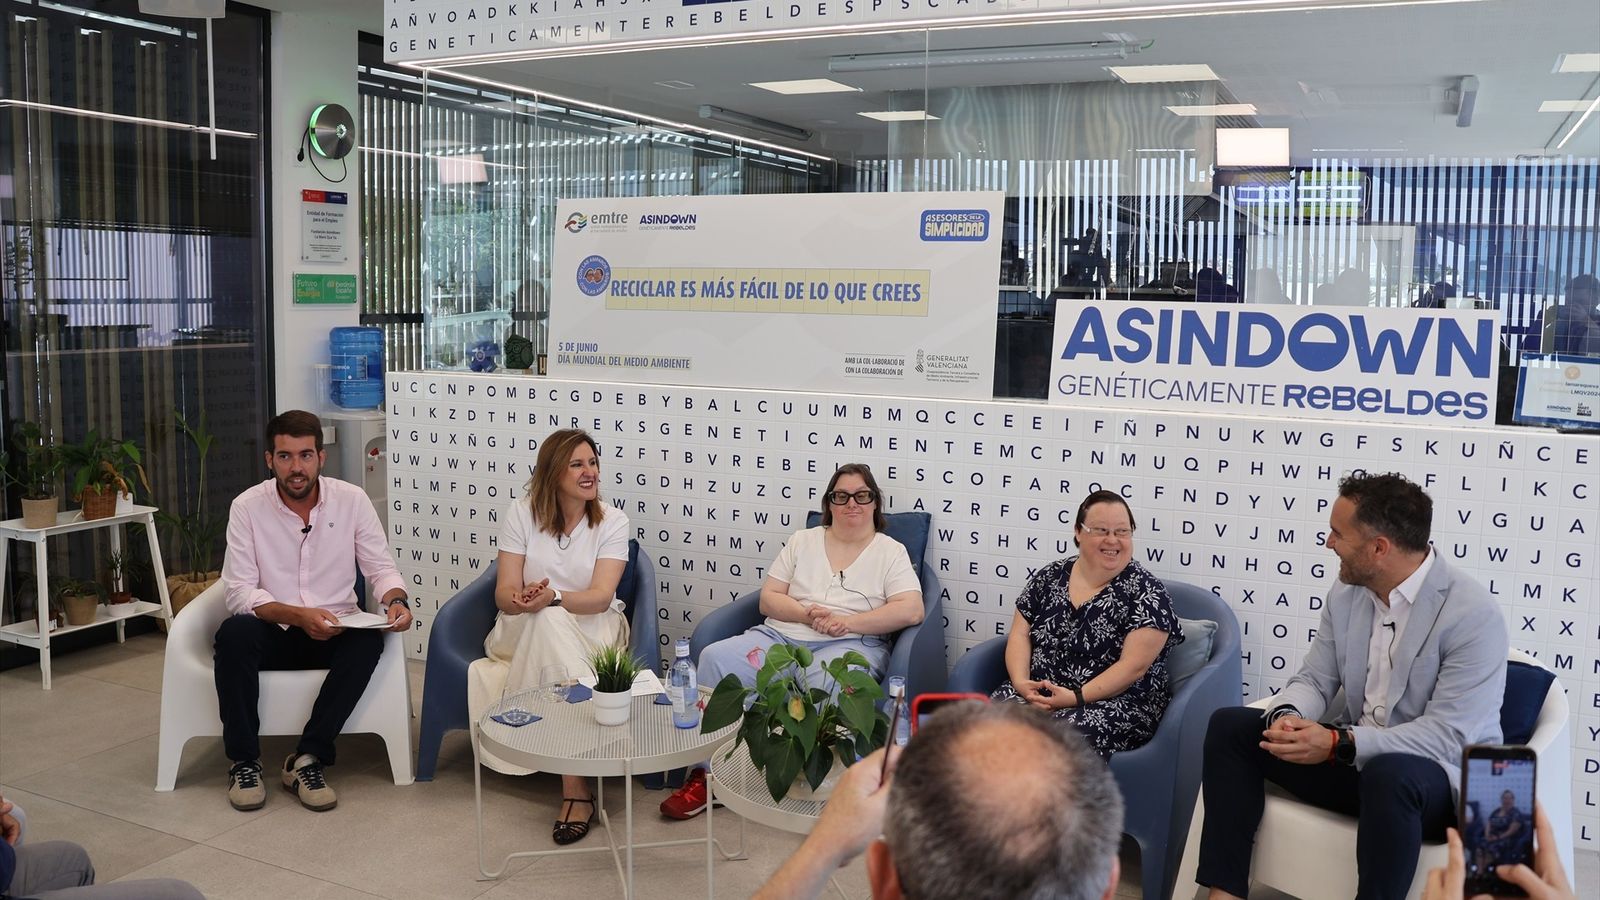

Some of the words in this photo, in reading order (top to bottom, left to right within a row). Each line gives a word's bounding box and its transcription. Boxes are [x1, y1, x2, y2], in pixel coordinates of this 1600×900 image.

[391, 18, 398, 28] A
[409, 16, 416, 26] Ñ
[429, 13, 436, 23] V
[448, 11, 456, 22] O
[468, 9, 476, 20] A
[488, 7, 496, 18] D
[509, 5, 516, 16] K
[531, 2, 538, 14] K
[390, 42, 397, 52] G
[410, 40, 416, 50] E
[429, 39, 436, 50] N
[449, 37, 454, 48] E
[468, 35, 475, 45] T
[509, 30, 516, 41] C
[530, 29, 538, 40] A
[550, 26, 561, 37] M
[575, 25, 580, 36] E
[596, 21, 604, 32] N
[620, 21, 627, 32] T
[643, 18, 650, 29] E
[666, 16, 673, 27] R
[690, 14, 697, 25] E
[714, 11, 722, 23] B
[740, 9, 747, 21] E
[767, 7, 773, 18] L
[791, 5, 800, 17] D
[818, 3, 826, 15] E
[846, 0, 853, 13] S
[873, 0, 881, 11] P
[591, 211, 628, 224] emtre
[640, 214, 696, 224] ASINDOWN
[926, 214, 966, 222] ASESORES
[925, 222, 984, 237] SIMPLICIDAD
[611, 280, 675, 298] RECICLAR
[681, 281, 696, 298] ES
[701, 276, 734, 299] MÁS
[740, 277, 779, 299] FÁCIL
[785, 282, 804, 299] DE
[809, 282, 828, 300] LO
[834, 282, 867, 304] QUE
[873, 283, 921, 302] CREES
[558, 342, 563, 351] 5
[566, 343, 575, 352] DE
[576, 343, 598, 354] JUNIO
[1060, 305, 1493, 378] ASINDOWN
[558, 353, 570, 364] DÍA
[573, 355, 606, 366] MUNDIAL
[609, 356, 621, 366] DEL
[624, 357, 648, 367] MEDIO
[651, 358, 690, 368] AMBIENTE
[862, 367, 896, 376] COLABORACIÓN
[1058, 371, 1276, 406] GENÉTICAMENTE
[393, 382, 399, 392] U
[411, 382, 417, 392] C
[429, 383, 436, 394] C
[448, 384, 456, 394] N
[469, 385, 474, 395] P
[487, 386, 496, 397] O
[507, 387, 516, 398] M
[529, 388, 535, 399] B
[550, 390, 557, 401] C
[571, 390, 579, 402] G
[593, 392, 602, 403] D
[616, 393, 623, 404] E
[639, 394, 646, 405] B
[662, 396, 670, 407] Y
[685, 397, 692, 409] B
[708, 399, 717, 411] A
[734, 400, 741, 412] L
[758, 401, 767, 413] C
[783, 402, 792, 414] U
[809, 404, 818, 416] U
[834, 405, 846, 417] M
[863, 407, 871, 419] B
[888, 408, 901, 421] M
[916, 410, 929, 423] Q
[945, 411, 955, 424] C
[974, 413, 984, 426] C
[1004, 415, 1013, 427] E
[1033, 417, 1041, 430] E
[1095, 420, 1104, 433] F
[1124, 423, 1136, 436] Ñ
[1156, 424, 1165, 437] P
[1187, 425, 1199, 439] N
[1219, 428, 1230, 441] U
[1253, 430, 1264, 444] K
[1284, 431, 1302, 445] W
[1320, 433, 1333, 447] G
[1357, 435, 1367, 449] F
[1392, 438, 1402, 452] S
[1426, 441, 1438, 455] K
[1462, 443, 1475, 457] U
[1499, 441, 1513, 459] Ñ
[1537, 446, 1550, 461] C
[1576, 449, 1588, 464] E
[660, 423, 669, 435] G
[685, 424, 692, 435] E
[708, 426, 717, 438] N
[734, 427, 741, 439] E
[758, 430, 766, 441] T
[808, 432, 817, 444] C
[834, 435, 845, 447] A
[860, 436, 872, 448] M
[889, 438, 897, 450] E
[916, 439, 926, 452] N
[944, 441, 954, 454] T
[974, 442, 982, 455] E
